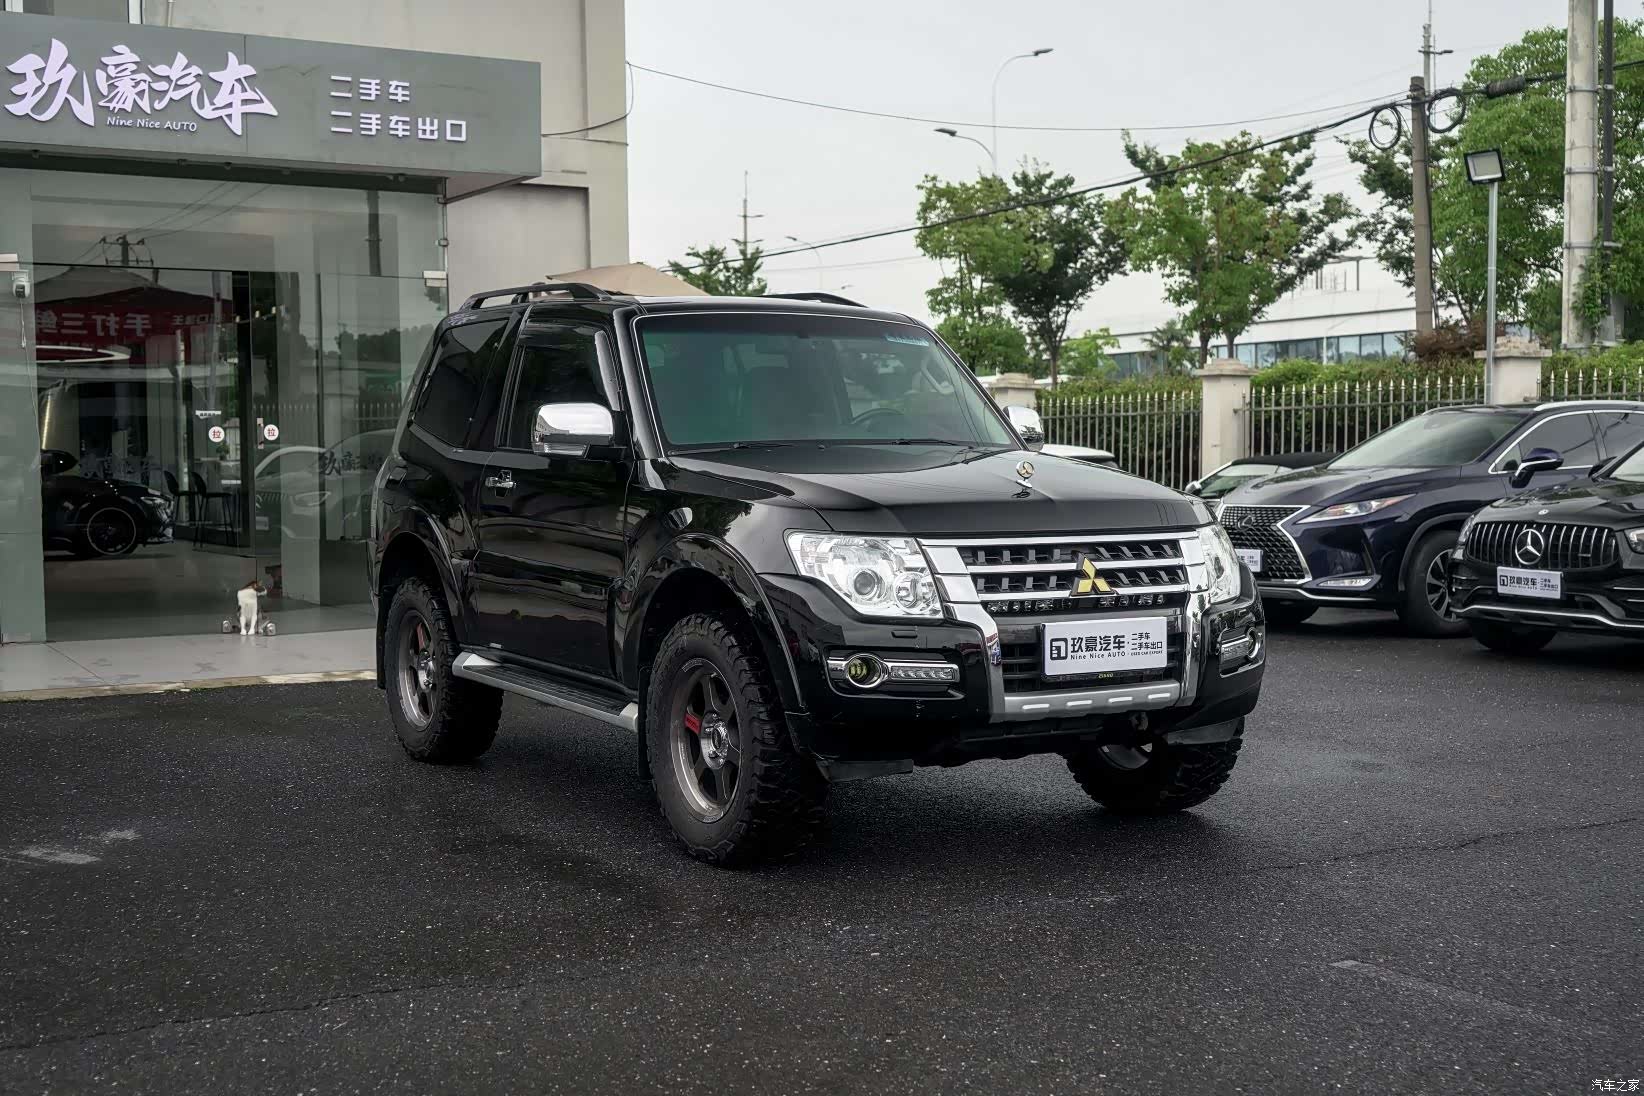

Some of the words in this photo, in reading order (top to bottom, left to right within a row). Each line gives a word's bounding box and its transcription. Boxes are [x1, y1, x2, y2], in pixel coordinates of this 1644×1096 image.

[5, 38, 279, 136] 玖豪汽车
[330, 75, 410, 103] 二手车
[106, 116, 133, 126] Nine
[136, 118, 161, 129] Nice
[164, 121, 197, 132] AUTO
[330, 111, 467, 142] 二手车出口
[212, 429, 222, 439] 拉
[267, 428, 276, 437] 拉
[1071, 634, 1126, 654] 玖豪汽车
[1131, 632, 1150, 641] 二手车
[1131, 641, 1163, 651] 二手车出口
